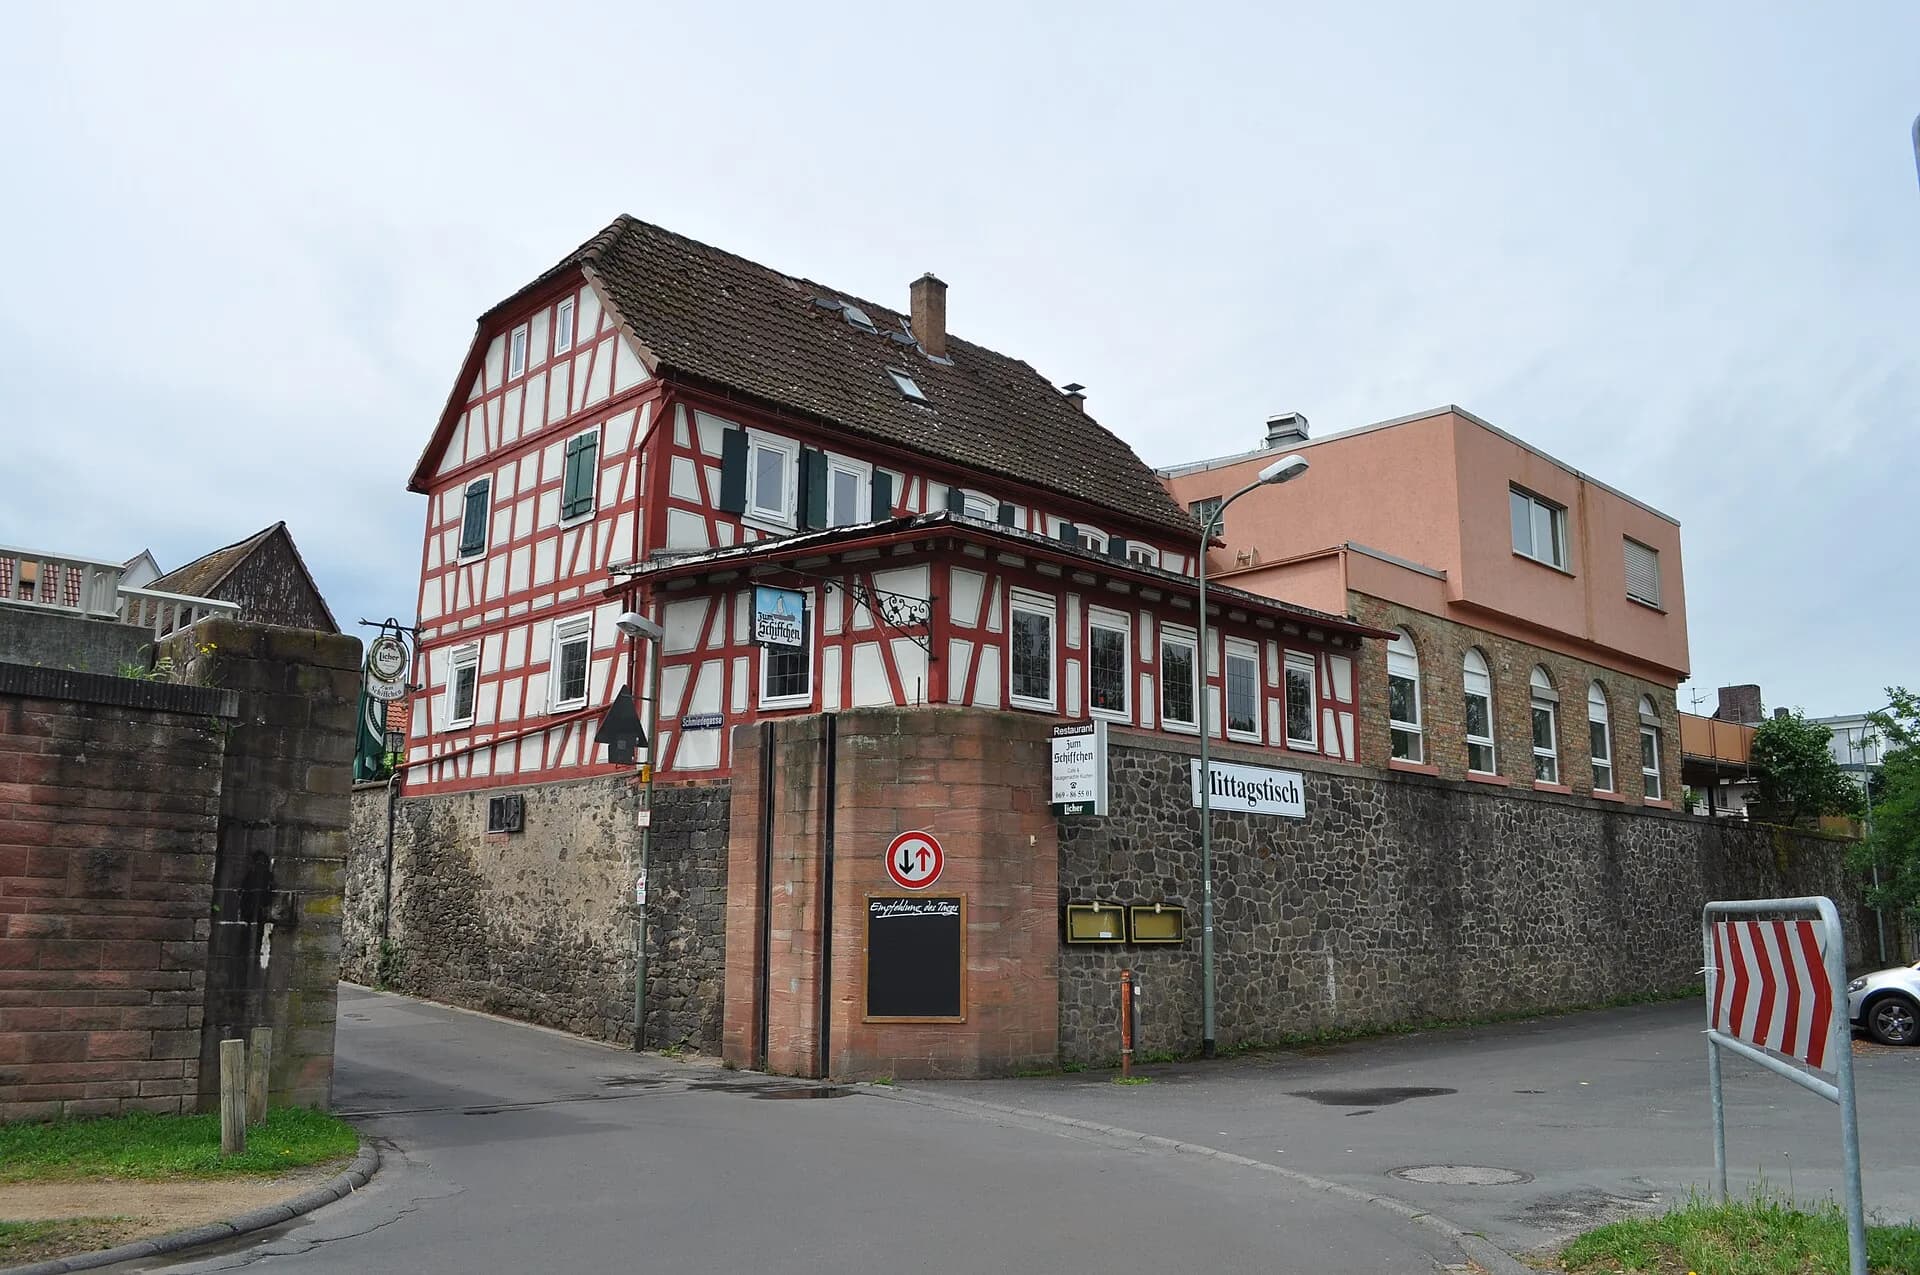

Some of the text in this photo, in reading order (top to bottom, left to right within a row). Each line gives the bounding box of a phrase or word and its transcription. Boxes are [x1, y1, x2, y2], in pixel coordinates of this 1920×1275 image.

[758, 620, 800, 643] Schiffchen
[379, 652, 400, 662] Licher
[1053, 723, 1093, 736] Restaurant
[1053, 751, 1093, 764] Schiffchen
[1198, 768, 1299, 808] Mittagstisch
[1064, 803, 1083, 815] Licher
[870, 899, 959, 916] Empfehlung des Tages
